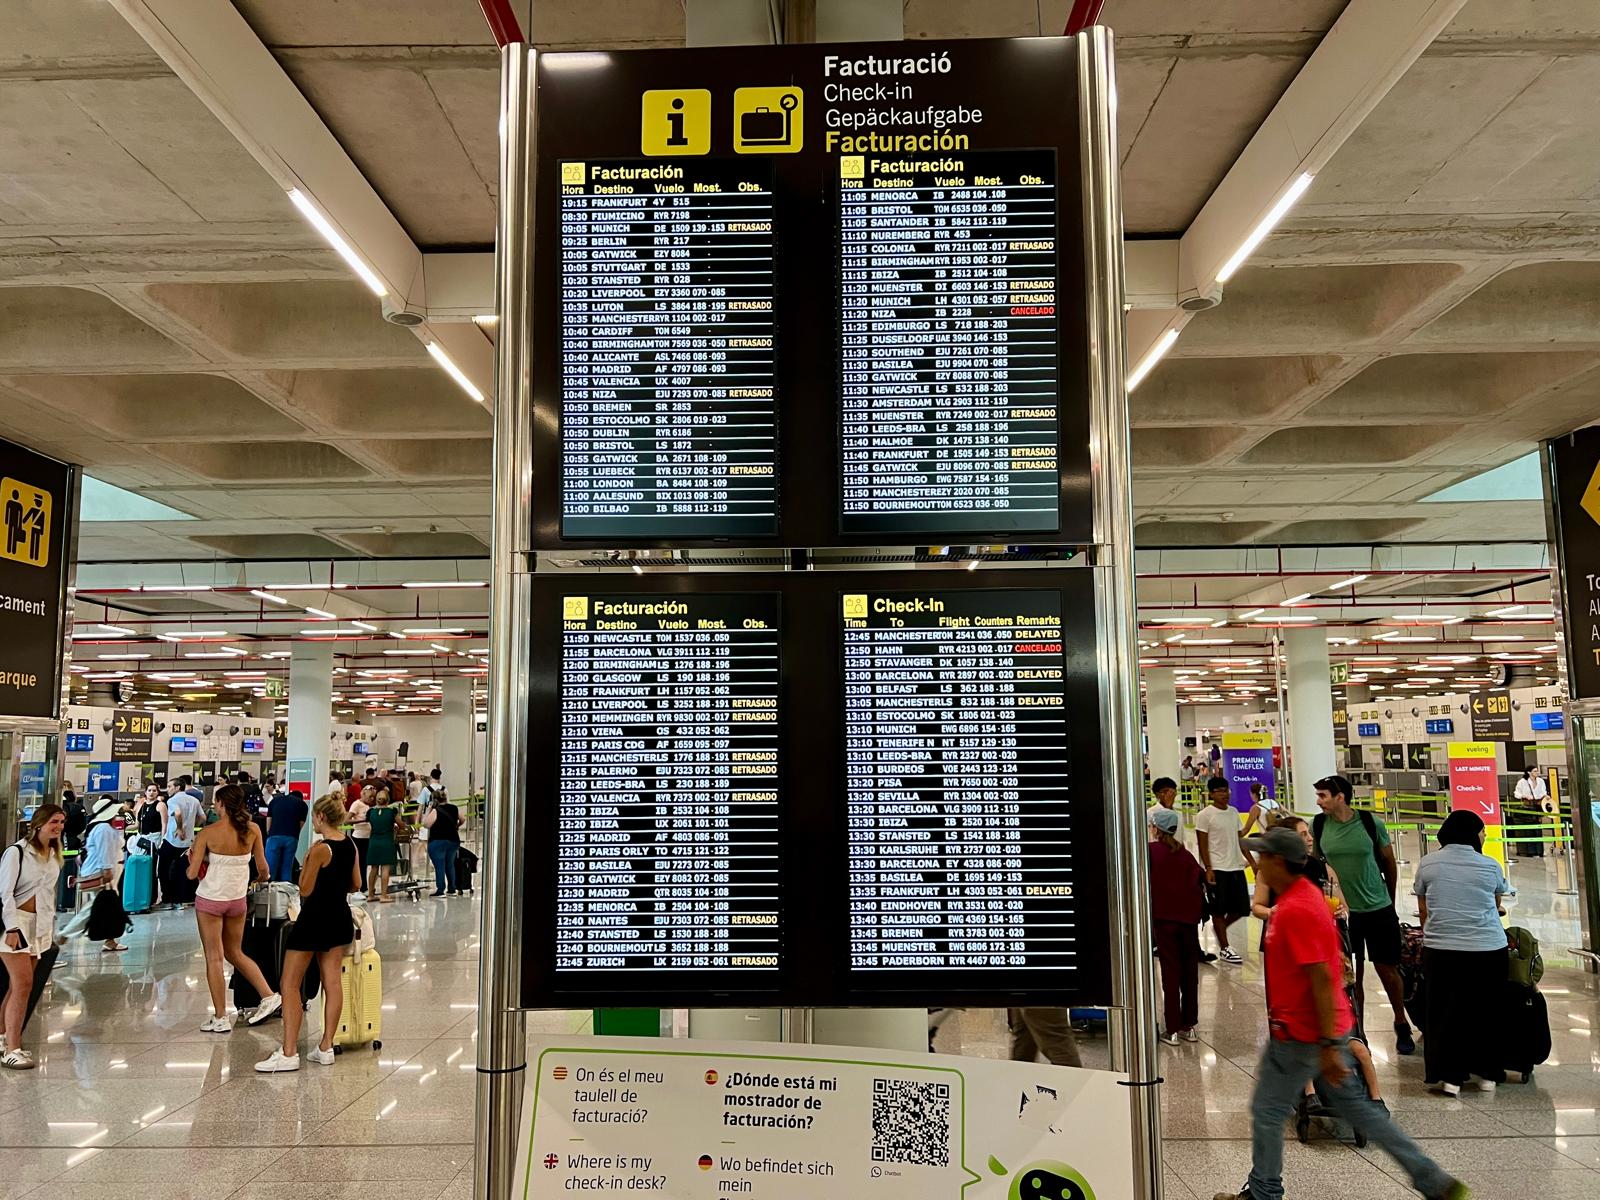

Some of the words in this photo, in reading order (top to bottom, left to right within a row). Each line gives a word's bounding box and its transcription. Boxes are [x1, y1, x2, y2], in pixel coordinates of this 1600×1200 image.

[825, 52, 951, 76] Facturació
[824, 82, 912, 102] Check-in
[826, 105, 982, 131] Gepäckaufgabe
[826, 129, 969, 152] Facturación
[871, 158, 963, 172] Facturación
[592, 166, 683, 179] Facturación
[874, 179, 913, 187] Destino
[935, 177, 965, 185] Vuelo
[975, 176, 1003, 185] Most.
[1020, 175, 1044, 184] Obs.
[562, 186, 584, 194] Hora
[594, 185, 633, 193] Destino
[655, 184, 684, 192] Vuelo
[694, 183, 721, 192] Most.
[738, 183, 762, 191] Obs.
[841, 193, 866, 201] 11:05
[871, 192, 918, 201] MENORCA
[933, 191, 944, 200] IB
[951, 191, 971, 199] 2488
[562, 199, 587, 208] 19:15
[592, 198, 647, 207] FRANKFURT
[653, 198, 665, 206] 4Y
[673, 197, 690, 206] 515
[562, 212, 588, 221] 08:30
[592, 212, 645, 221] FIUMICINO
[654, 211, 669, 220] RYR
[671, 211, 690, 219] 7198
[562, 225, 587, 233] 09:05
[591, 224, 630, 233] MUNICH
[728, 223, 771, 231] RETRASADO
[562, 237, 587, 246] 09:25
[591, 237, 627, 246] BERLIN
[842, 245, 867, 254] 11:15
[871, 244, 916, 253] COLONIA
[1009, 241, 1054, 250] RETRASADO
[563, 264, 588, 272] 10:05
[591, 263, 647, 272] STUTTGART
[842, 271, 867, 280] 11:15
[871, 271, 899, 279] IBIZA
[842, 310, 868, 319] 11:20
[872, 310, 896, 318] NIZA
[1010, 306, 1055, 315] CANCELADO
[842, 323, 868, 331] 11:25
[872, 322, 930, 331] EDIMBURGO
[843, 361, 868, 370] 11:30
[872, 360, 913, 369] BASILEA
[564, 378, 588, 386] 10:45
[592, 377, 640, 386] VALENCIA
[564, 468, 589, 476] 10:55
[593, 467, 635, 475] LUEBECK
[730, 466, 773, 474] RETRASADO
[844, 476, 869, 485] 11:50
[873, 475, 928, 484] HAMBURGO
[564, 505, 589, 513] 11:00
[593, 505, 629, 513] BILBAO
[595, 602, 687, 615] Facturación
[874, 598, 943, 612] Check-In
[564, 621, 586, 630] Hora
[597, 621, 636, 629] Destino
[659, 620, 688, 629] Vuelo
[698, 620, 726, 628] Most.
[743, 620, 767, 628] Obs.
[844, 619, 867, 628] Time
[890, 618, 904, 626] To
[939, 618, 970, 628] Flight
[975, 617, 1013, 626] Counters
[1017, 616, 1060, 625] Remarks
[564, 634, 589, 643] 11:50
[594, 634, 652, 643] NEWCASTLE
[845, 646, 870, 655] 12:50
[875, 646, 903, 654] HAHN
[1015, 644, 1062, 652] CANCELADO
[845, 659, 871, 667] 12:50
[875, 658, 933, 667] STAVANGER
[563, 674, 589, 683] 12:00
[592, 674, 641, 683] GLASGOW
[846, 685, 871, 694] 13:00
[876, 685, 918, 693] BELFAST
[562, 701, 588, 709] 12:10
[592, 700, 648, 709] LIVERPOOL
[732, 699, 777, 708] RETRASADO
[846, 712, 872, 721] 13:10
[876, 711, 935, 720] ESTOCOLMO
[562, 728, 588, 736] 12:10
[591, 727, 623, 736] VIENA
[561, 767, 587, 776] 12:15
[591, 767, 638, 775] PALERMO
[732, 765, 777, 774] RETRASADO
[847, 765, 873, 774] 13:10
[877, 765, 924, 774] BURDEOS
[559, 834, 585, 842] 12:25
[590, 833, 631, 842] MADRID
[850, 887, 876, 896] 13:35
[880, 887, 940, 896] FRANKFURT
[1026, 886, 1072, 895] DELAYED
[557, 917, 584, 925] 12:40
[588, 916, 628, 925] NANTES
[732, 915, 777, 924] RETRASADO
[851, 915, 877, 924] 13:40
[881, 915, 941, 924] SALZBURGO
[557, 958, 583, 967] 12:45
[587, 957, 625, 966] ZURICH
[732, 957, 778, 965] RETRASADO
[851, 957, 878, 966] 13:45
[882, 956, 944, 965] PADERBORN
[576, 1068, 595, 1082] On
[599, 1068, 614, 1082] és
[618, 1069, 630, 1082] el
[638, 1072, 664, 1083] meu
[725, 1072, 779, 1088] ¿Dónde
[784, 1076, 815, 1090] está
[819, 1077, 837, 1091] mi
[574, 1088, 617, 1102] taulell
[621, 1090, 637, 1103] de
[724, 1094, 800, 1108] mostrador
[804, 1096, 822, 1110] de
[572, 1109, 648, 1123] facturació?
[723, 1111, 813, 1129] facturación?
[568, 1154, 612, 1168] Where
[616, 1154, 627, 1168] is
[631, 1158, 652, 1172] my
[720, 1156, 741, 1171] Wo
[745, 1158, 803, 1174] befindet
[807, 1161, 833, 1176] sich
[565, 1175, 623, 1190] check-in
[627, 1175, 666, 1190] desk?
[719, 1179, 752, 1192] mein
